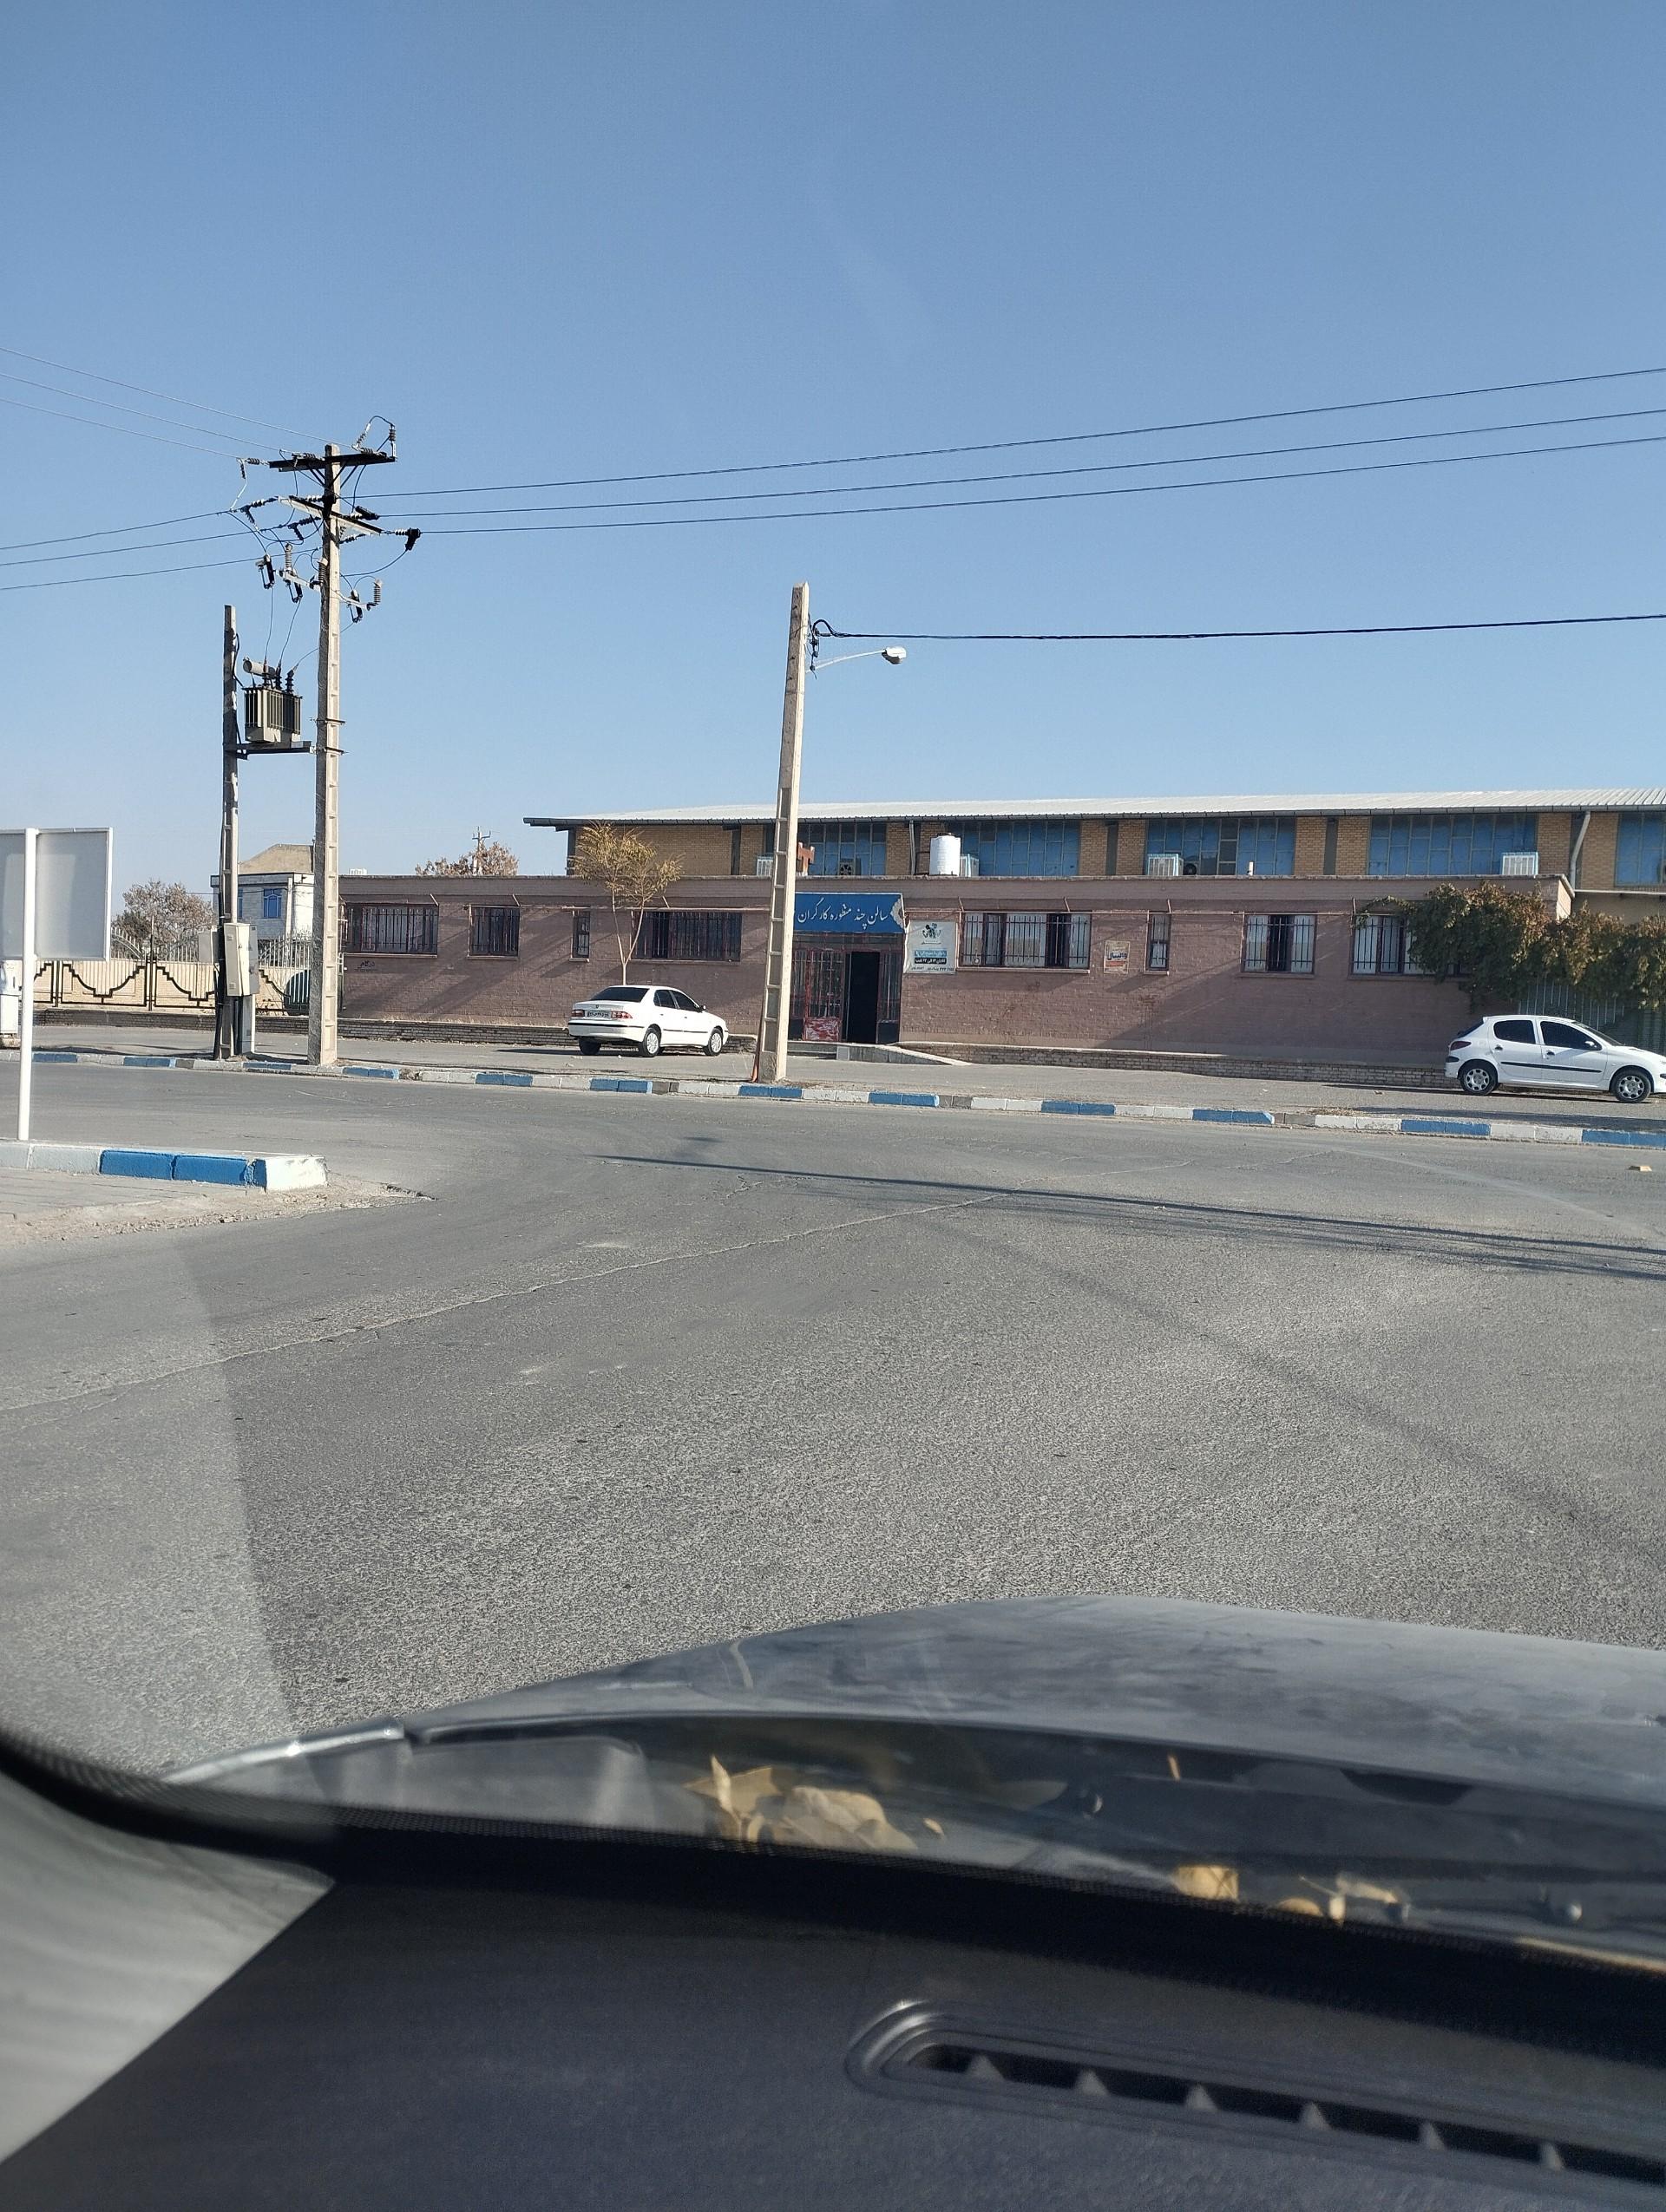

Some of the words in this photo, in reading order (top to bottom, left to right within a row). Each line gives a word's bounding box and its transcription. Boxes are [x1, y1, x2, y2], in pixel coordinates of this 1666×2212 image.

[797, 897, 831, 923] کارگران
[830, 903, 852, 921] منظوره
[853, 908, 866, 930] چند
[867, 906, 889, 925] سالن
